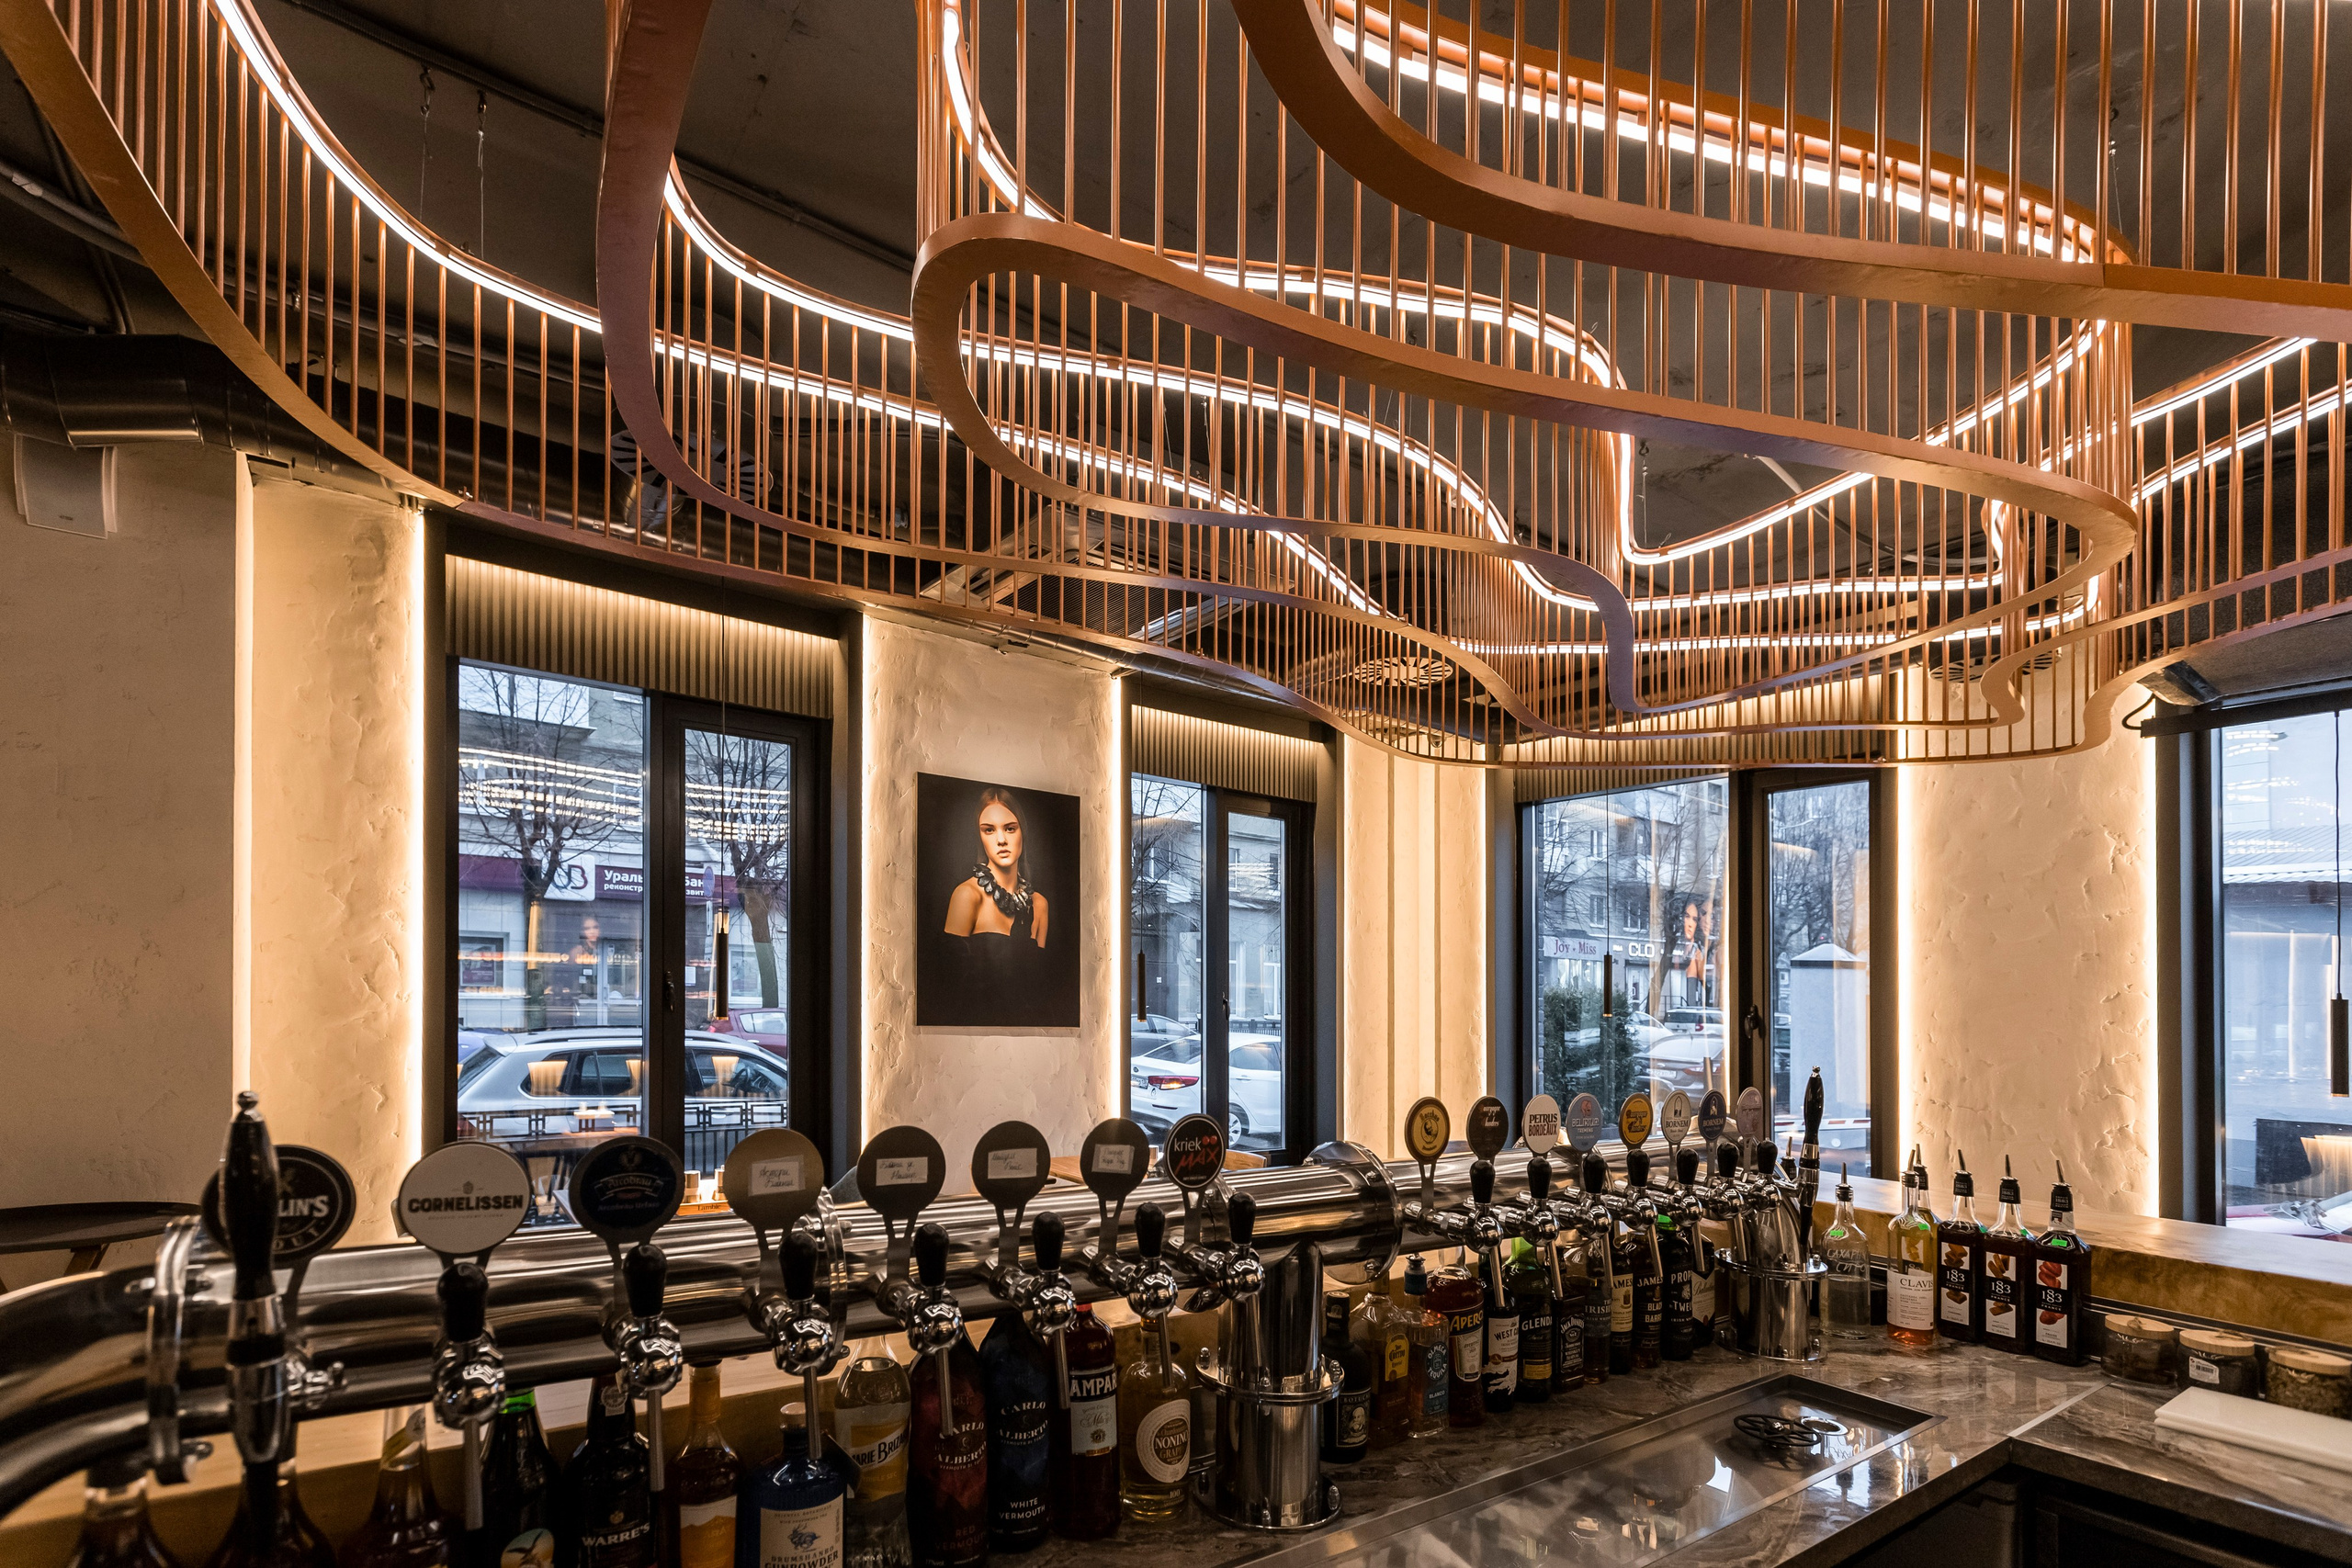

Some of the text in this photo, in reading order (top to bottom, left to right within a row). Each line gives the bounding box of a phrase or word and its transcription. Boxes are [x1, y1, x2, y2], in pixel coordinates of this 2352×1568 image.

[1628, 942, 1655, 957] CLO
[1529, 1113, 1558, 1124] PETRUS
[1665, 1120, 1689, 1128] BORNEM
[1702, 1118, 1724, 1127] BORNEM
[1528, 1123, 1557, 1136] BORDEAUX
[1173, 1136, 1202, 1152] kriek
[1174, 1145, 1220, 1177] MAX
[408, 1194, 524, 1213] CORNELISSEN
[1494, 1328, 1512, 1341] WEST
[1428, 1344, 1447, 1359] OLMECA
[1427, 1363, 1447, 1379] TEQUILA
[1429, 1390, 1445, 1399] BLANCO
[1001, 1401, 1046, 1416] CARLO
[1011, 1496, 1038, 1509] WHITE
[999, 1505, 1046, 1520] VERMOUTH
[581, 1521, 650, 1547] WARRE'S
[956, 1525, 976, 1537] RED
